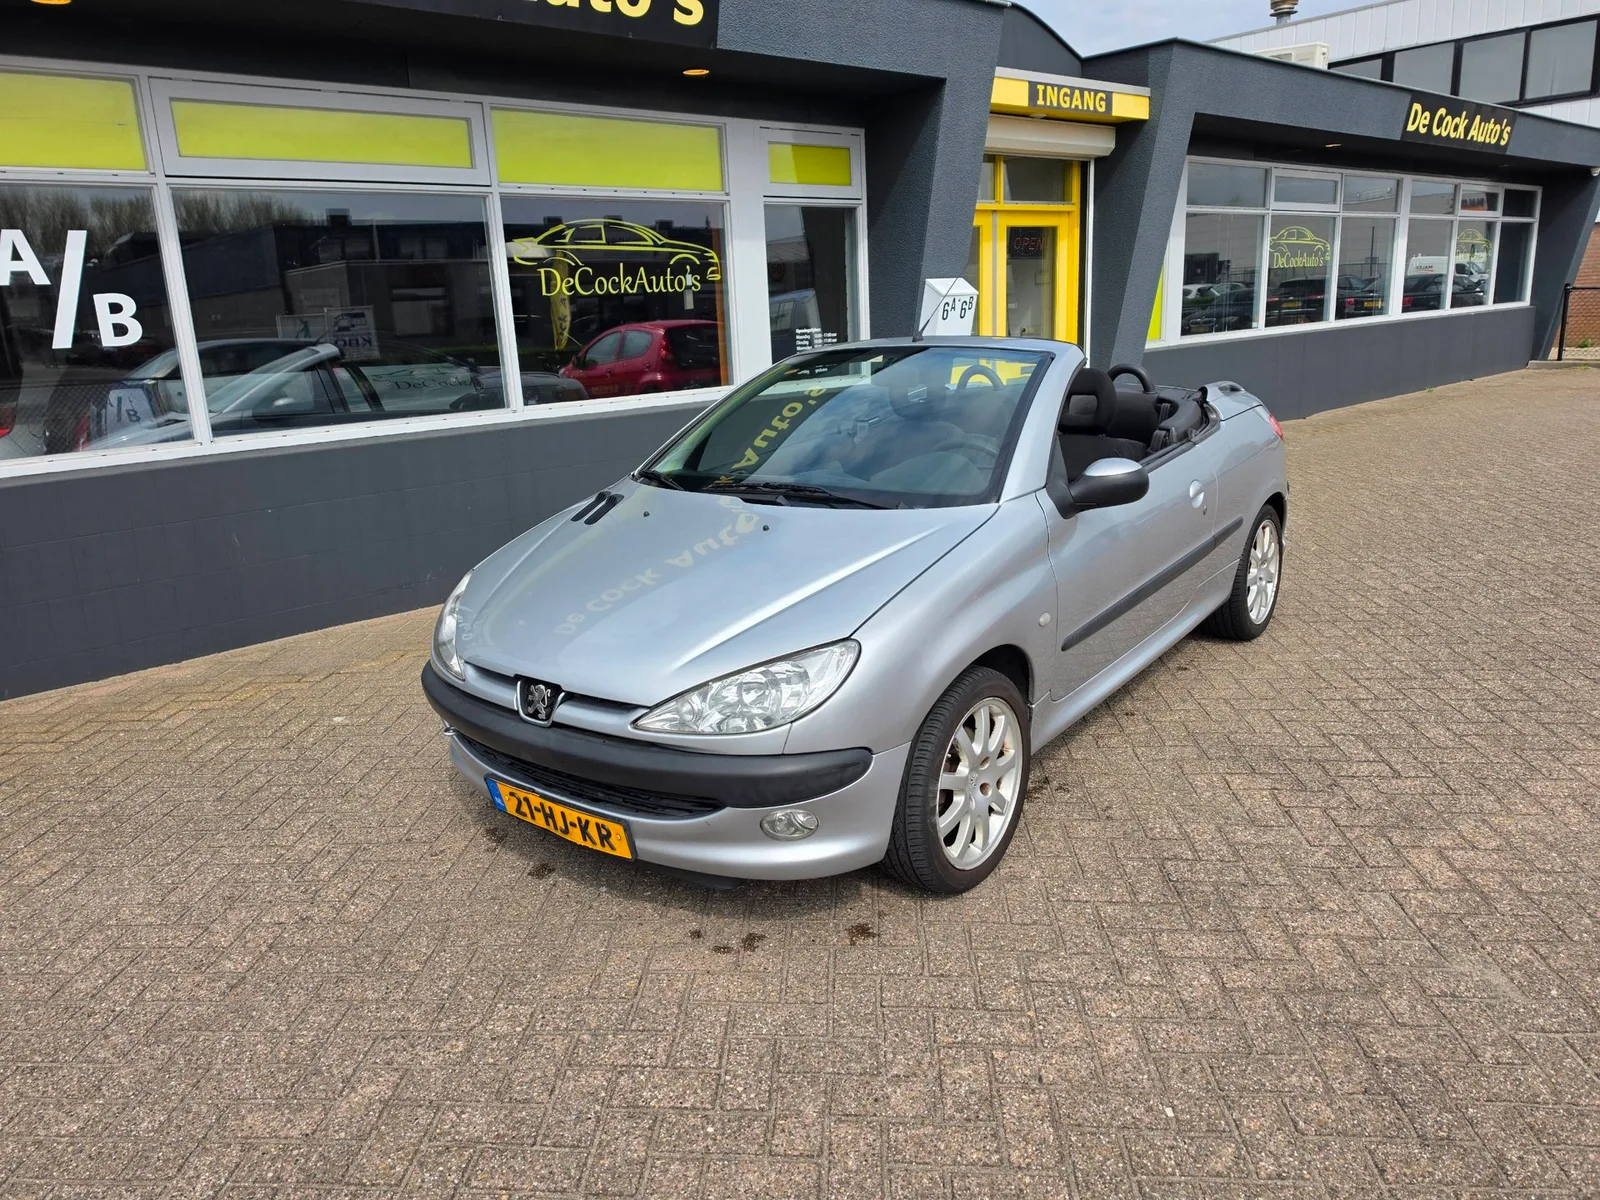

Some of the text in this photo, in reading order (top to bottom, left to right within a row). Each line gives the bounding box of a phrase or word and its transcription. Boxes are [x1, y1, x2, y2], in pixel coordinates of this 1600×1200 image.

[1036, 84, 1107, 113] INGANG
[1406, 102, 1511, 146] De Cock Auto's
[1013, 236, 1047, 250] OPEN
[508, 791, 617, 851] 21-HJ-KR
